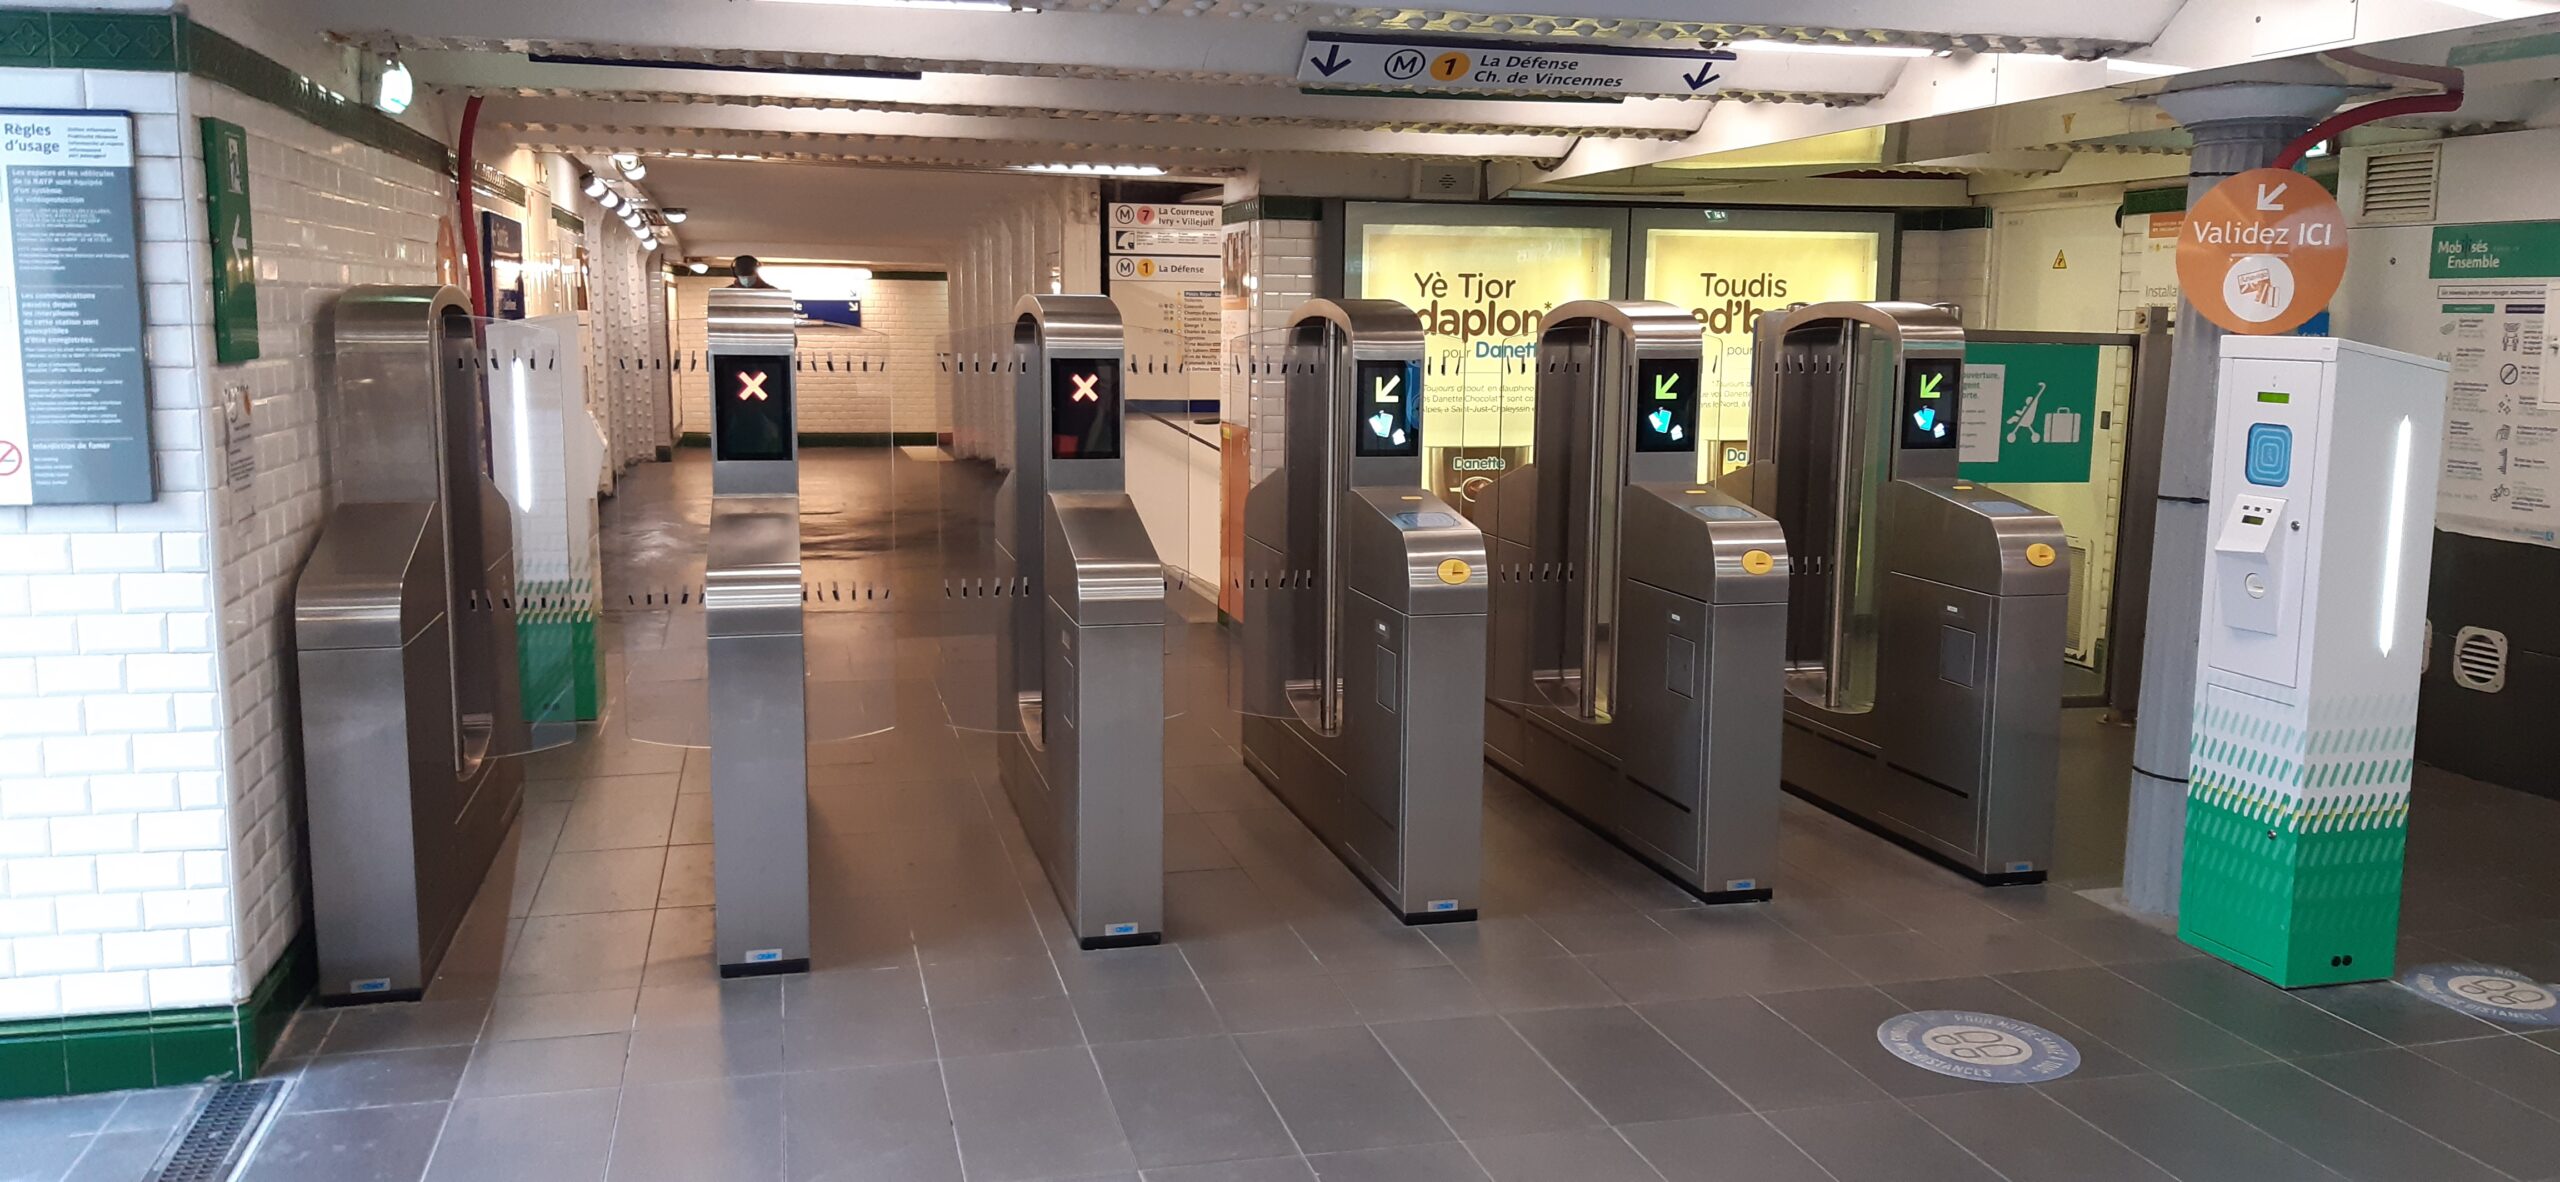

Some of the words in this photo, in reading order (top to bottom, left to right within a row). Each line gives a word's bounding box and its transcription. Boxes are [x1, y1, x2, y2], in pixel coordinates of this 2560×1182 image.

[1445, 58, 1456, 75] 1
[1480, 55, 1500, 67] La
[1506, 56, 1579, 71] Défense
[1474, 70, 1500, 83] Ch.
[1506, 72, 1528, 84] de
[1535, 73, 1623, 87] Vincennes
[4, 122, 51, 138] Règles
[5, 139, 60, 155] d'usage
[1142, 210, 1150, 220] 7
[1171, 208, 1214, 216] Courneuve
[1158, 217, 1174, 226] Ivry
[1182, 218, 1215, 227] Villejuif
[2193, 221, 2289, 245] Validez
[2298, 223, 2332, 246] ICI
[1143, 263, 1149, 273] 1
[1159, 265, 1168, 273] La
[1171, 264, 1204, 273] Défense
[2447, 254, 2500, 269] Ensemble
[1414, 271, 1448, 298] Yè
[1458, 272, 1516, 304] Tjor
[1700, 272, 1787, 298] Toudis
[2145, 284, 2178, 298] Installa
[1443, 348, 1471, 359] pour
[1499, 384, 1535, 392] dauphino
[1454, 457, 1505, 470] Danette
